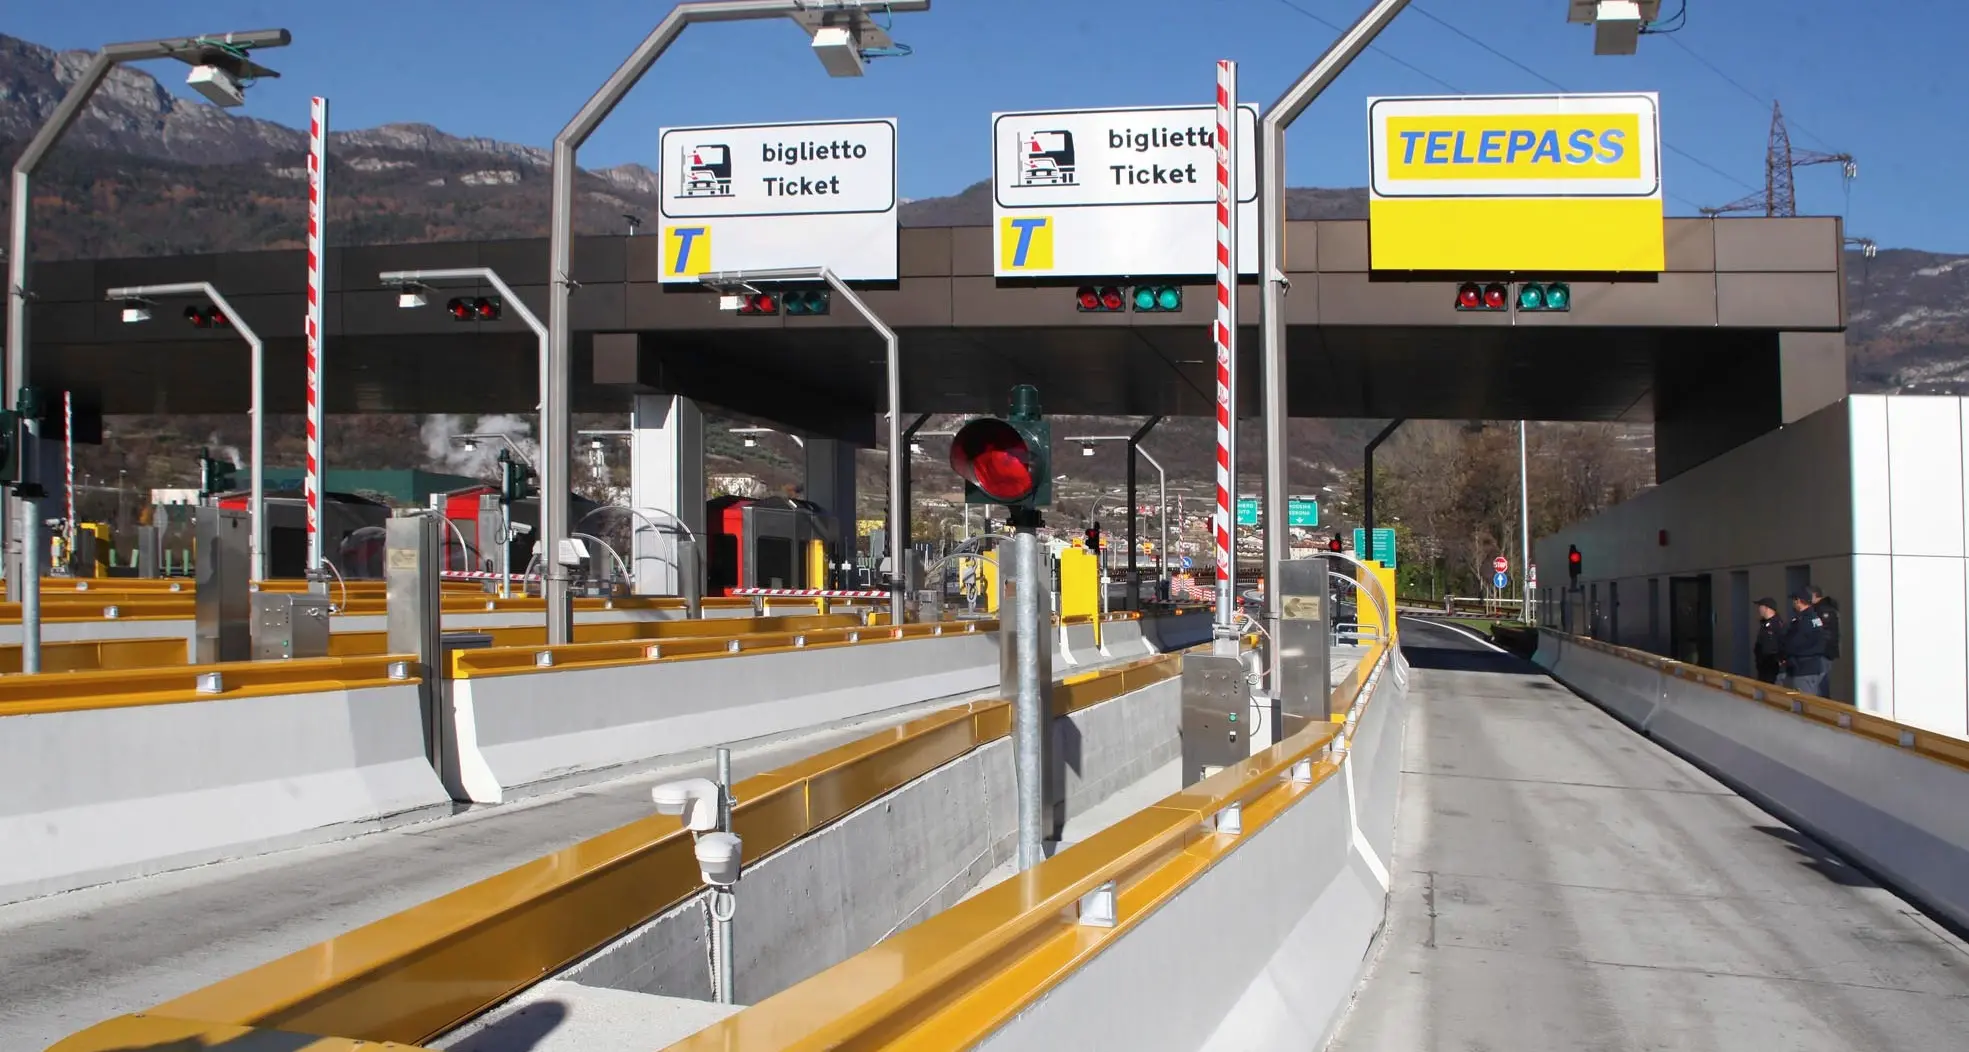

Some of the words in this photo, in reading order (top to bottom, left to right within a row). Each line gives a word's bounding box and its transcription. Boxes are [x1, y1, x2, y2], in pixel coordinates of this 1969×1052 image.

[762, 140, 868, 166] biglietto
[1109, 126, 1212, 153] bigliett
[1400, 128, 1625, 165] TELEPASS
[762, 175, 840, 197] Ticket
[1110, 163, 1197, 185] Ticket
[672, 227, 705, 273] T
[1011, 218, 1047, 267] T
